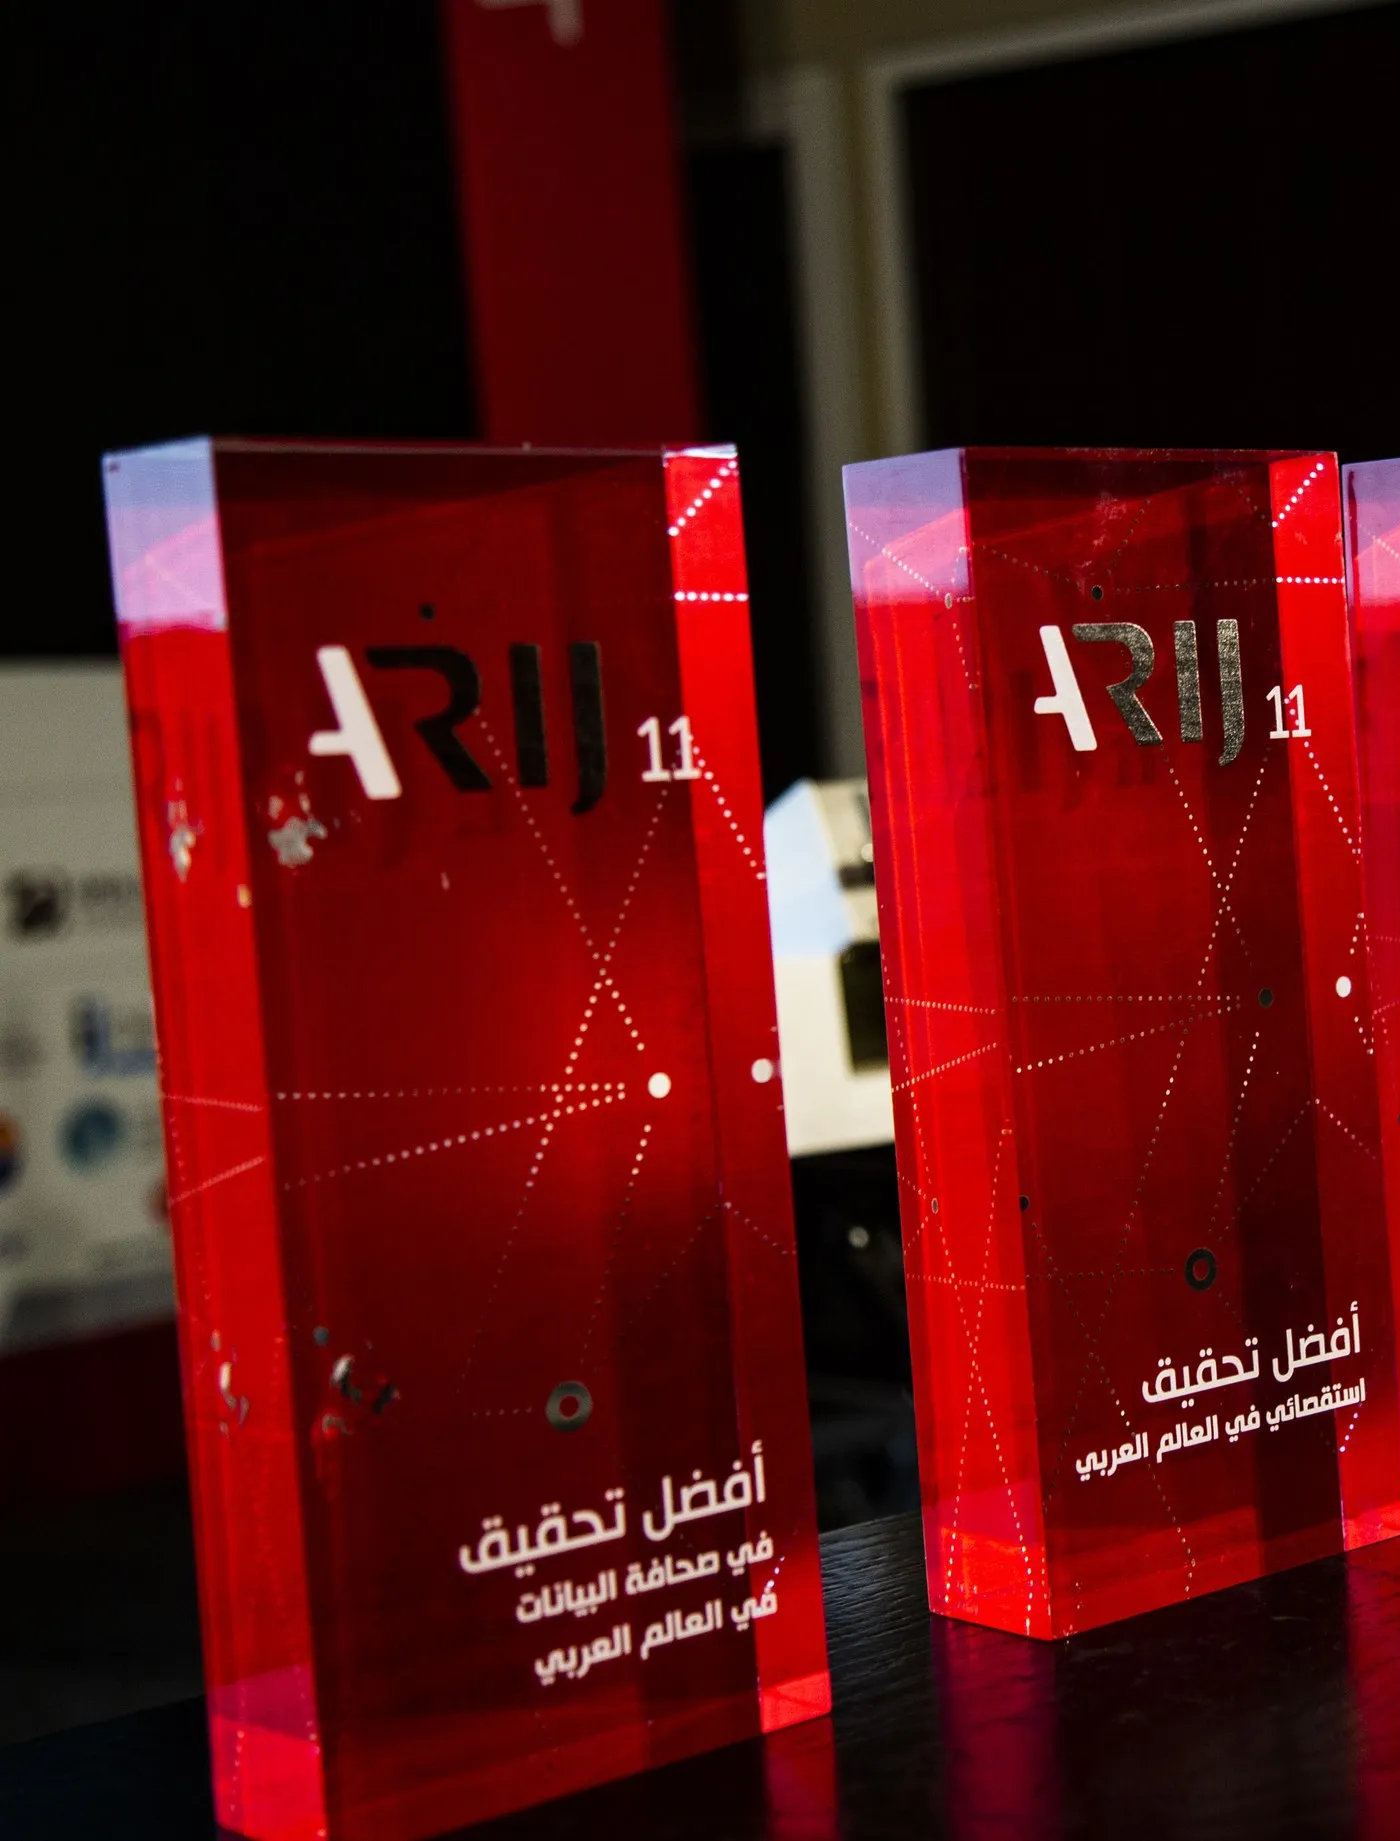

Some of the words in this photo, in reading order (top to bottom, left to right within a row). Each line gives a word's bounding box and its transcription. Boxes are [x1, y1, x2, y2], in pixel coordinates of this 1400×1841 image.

[1034, 619, 1245, 767] ARIJ
[1266, 684, 1312, 740] 11
[309, 640, 607, 816] ARIJ
[636, 714, 702, 782] 11
[1272, 1300, 1361, 1382] أفضل
[1141, 1337, 1260, 1408] تحقيق
[1224, 1405, 1260, 1442] في
[1265, 1377, 1366, 1431] استقصائي
[1075, 1432, 1148, 1481] العربي
[1156, 1414, 1219, 1463] العالم
[643, 1439, 765, 1541] أفضل
[458, 1488, 626, 1578] تحقيق
[726, 1530, 774, 1575] في
[516, 1569, 618, 1623] البيانات
[625, 1551, 720, 1595] صحافة
[640, 1599, 723, 1660] العالم
[730, 1585, 778, 1631] في
[534, 1623, 632, 1686] العربي
